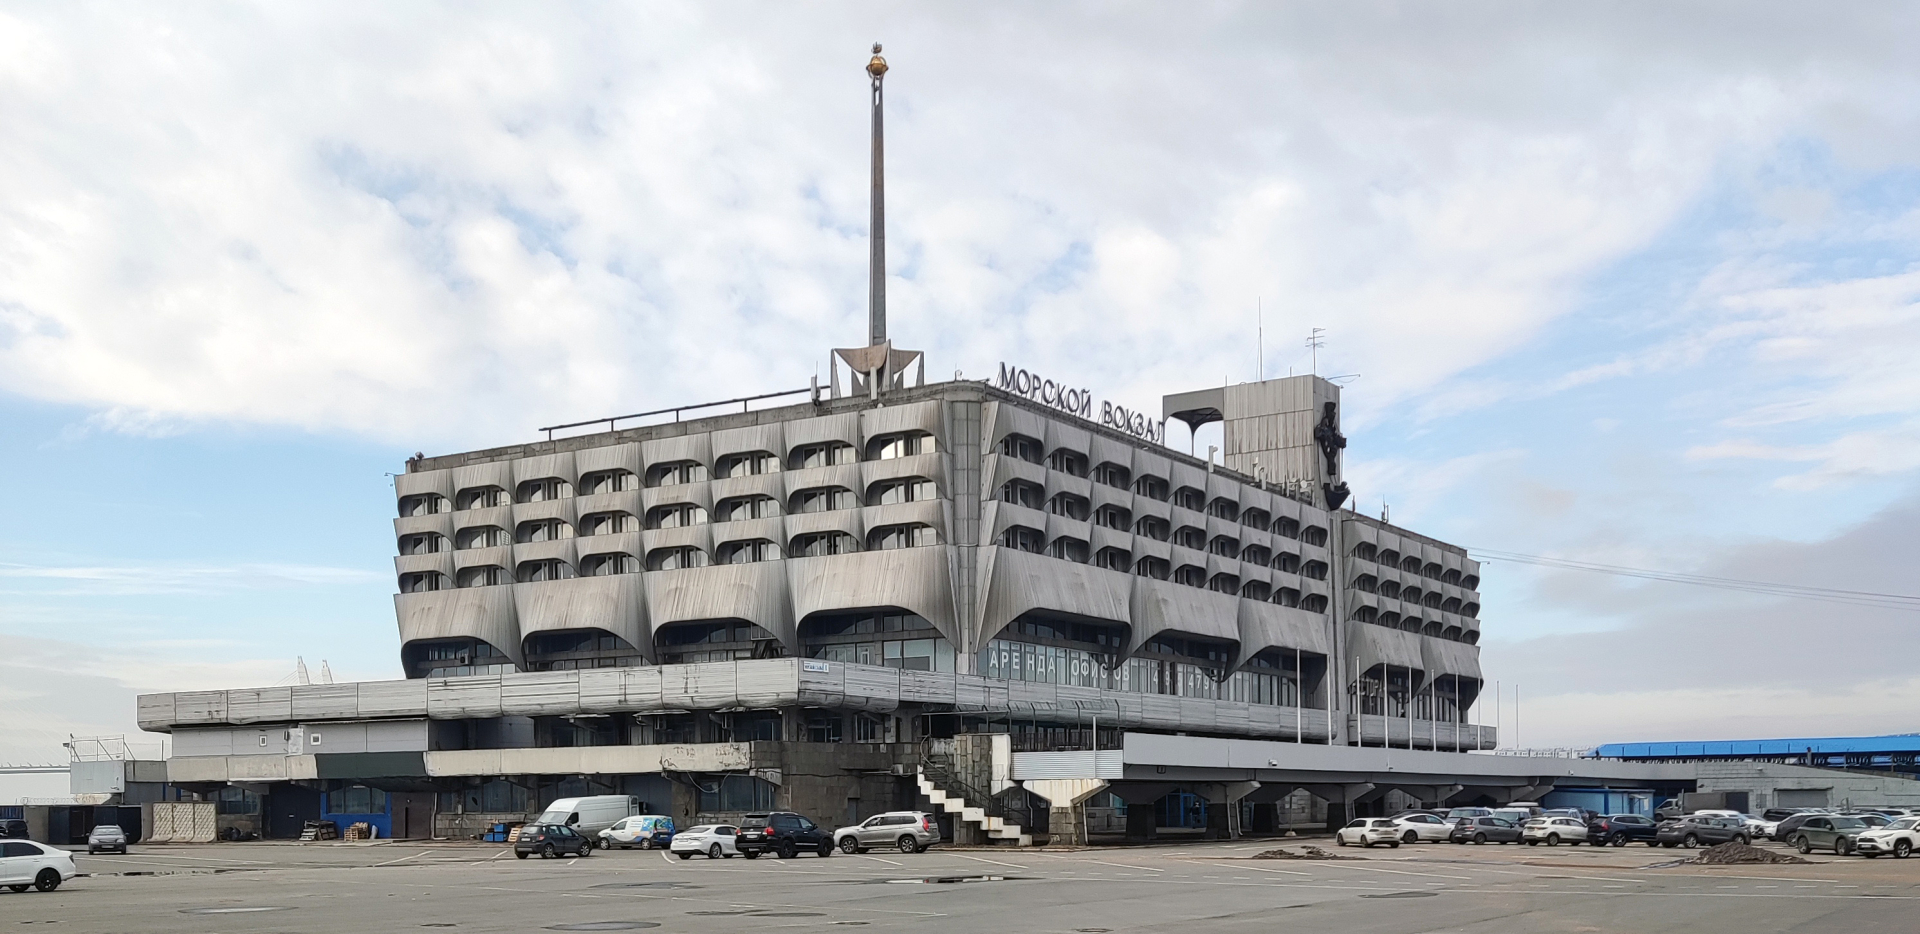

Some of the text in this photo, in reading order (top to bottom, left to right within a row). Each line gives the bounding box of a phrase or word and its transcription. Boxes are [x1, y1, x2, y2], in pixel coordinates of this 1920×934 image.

[1000, 361, 1165, 445] МОРСКОЙ ВОКЗАЛ
[989, 650, 1056, 675] АРЕНДА
[1071, 659, 1130, 681] ОФИСОВ
